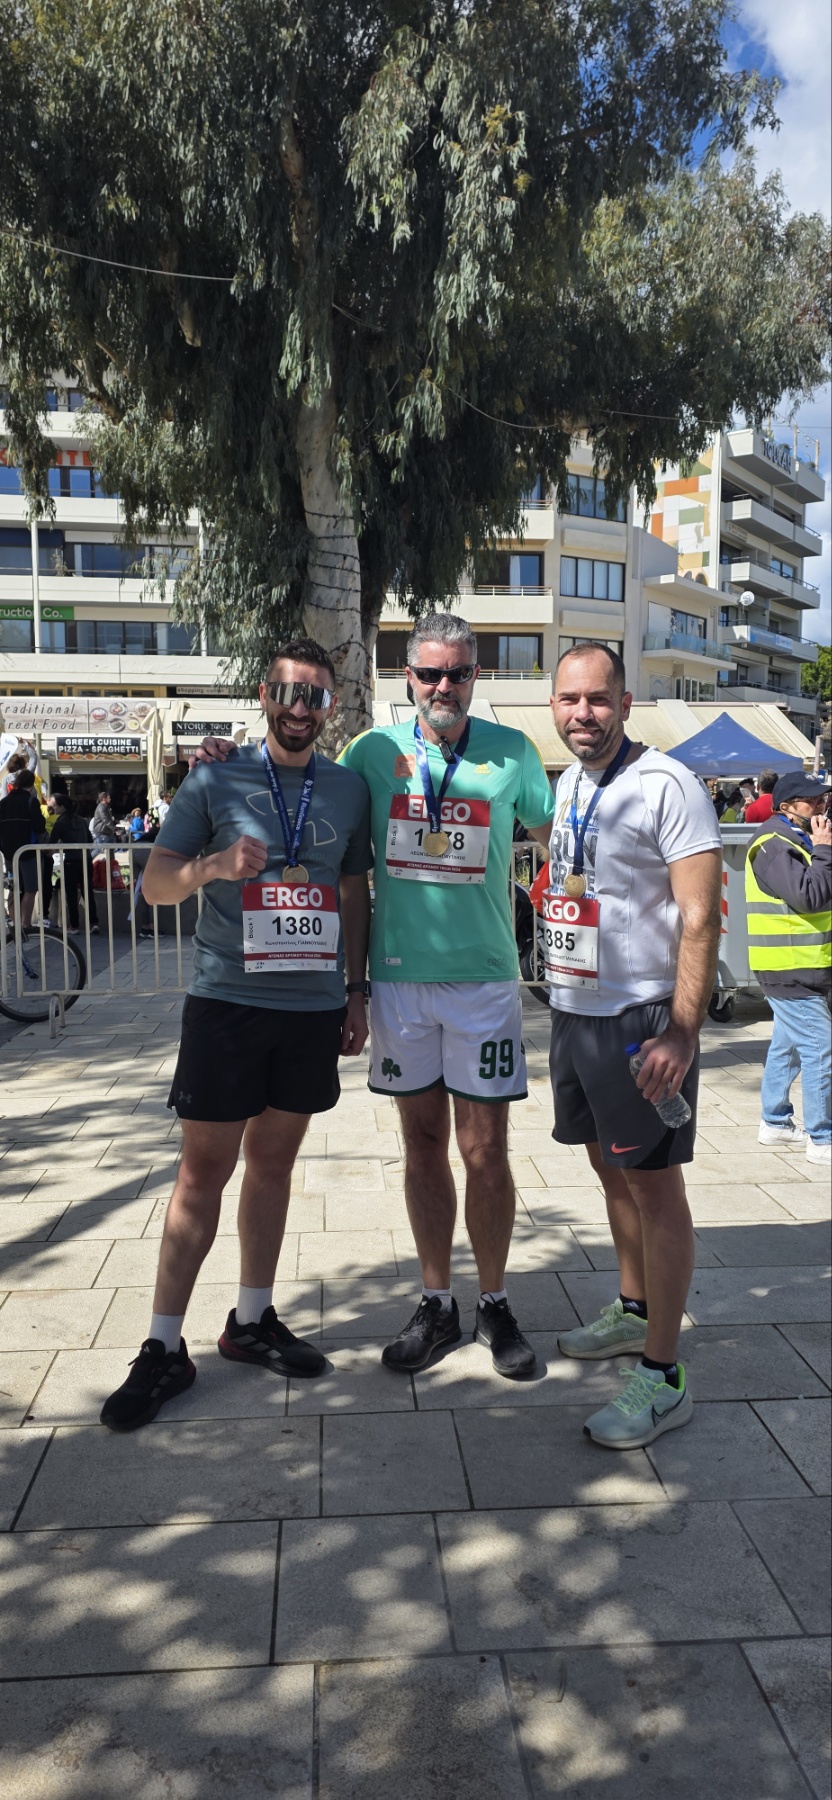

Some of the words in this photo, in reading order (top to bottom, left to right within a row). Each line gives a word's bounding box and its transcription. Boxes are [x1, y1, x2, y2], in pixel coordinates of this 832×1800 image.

[0, 607, 35, 617] ructio
[42, 607, 63, 618] Co.
[4, 718, 38, 730] reek
[42, 718, 76, 730] Food
[58, 745, 83, 753] PIZZA
[91, 745, 139, 753] SPAGHETTI
[65, 738, 95, 746] GREEK
[97, 738, 132, 746] CUISINE
[414, 828, 464, 850] 18
[551, 862, 595, 892] CRE
[262, 886, 323, 908] ERGO
[542, 897, 580, 922] RGO
[272, 916, 322, 936] 1380
[546, 928, 575, 951] 385
[478, 1038, 514, 1080] 99
